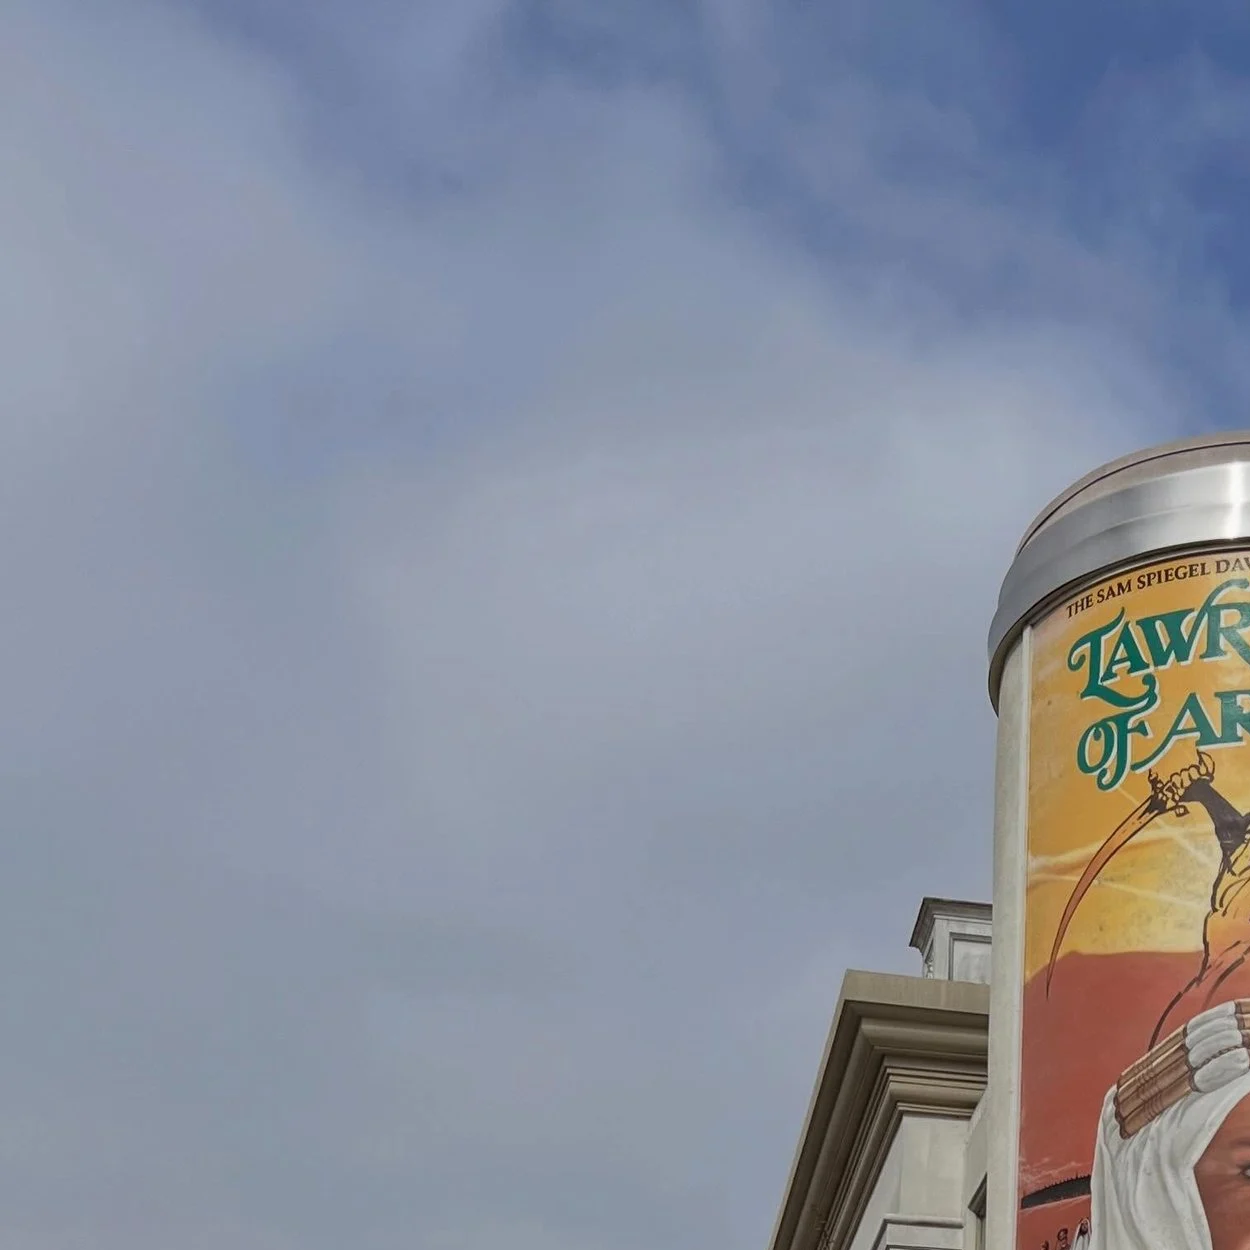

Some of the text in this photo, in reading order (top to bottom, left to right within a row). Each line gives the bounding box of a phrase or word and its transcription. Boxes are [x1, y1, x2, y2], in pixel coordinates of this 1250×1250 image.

[1066, 594, 1094, 619] THE
[1097, 577, 1132, 604] SAM
[1137, 562, 1211, 590] SPIEGEL
[1076, 708, 1151, 791] OF
